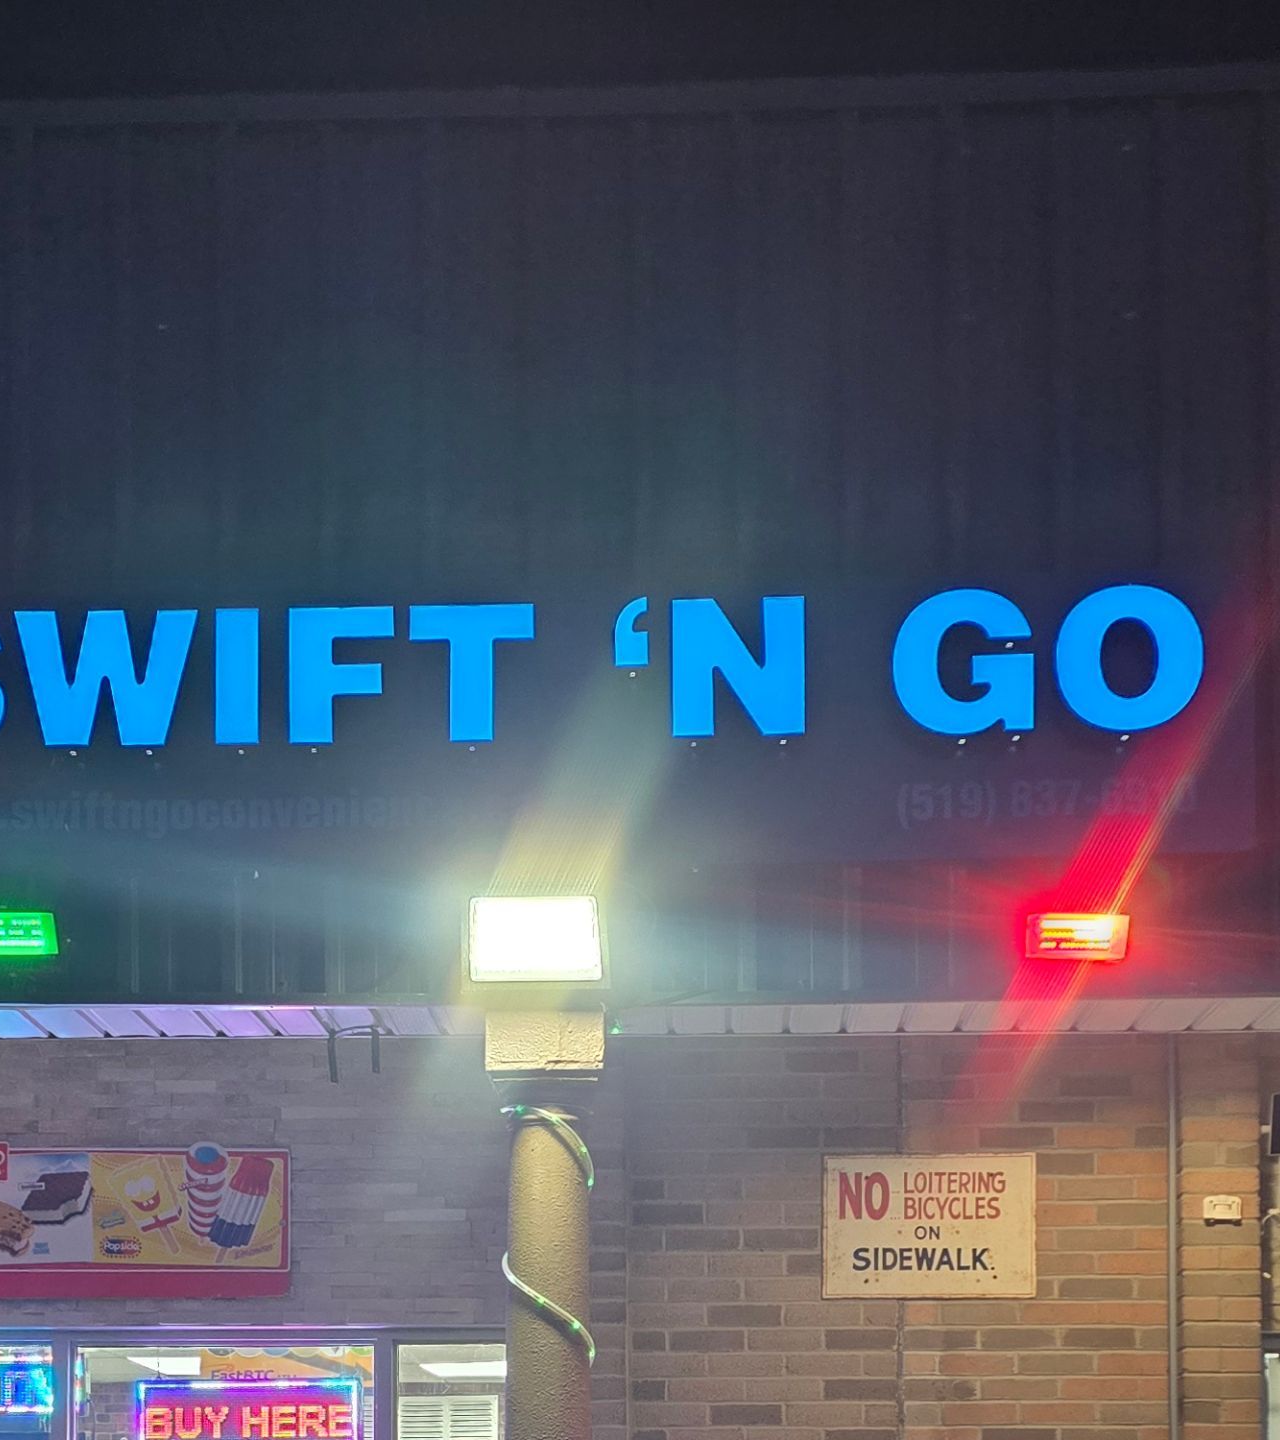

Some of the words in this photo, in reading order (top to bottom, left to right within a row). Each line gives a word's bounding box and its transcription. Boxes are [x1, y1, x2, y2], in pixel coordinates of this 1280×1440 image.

[891, 584, 1204, 735] GO
[838, 1171, 890, 1221] NO
[903, 1171, 1006, 1194] LOITERING
[903, 1197, 1001, 1220] BICYCLES
[914, 1226, 941, 1240] ON
[145, 1405, 230, 1440] BUY
[241, 1404, 352, 1438] HERE
